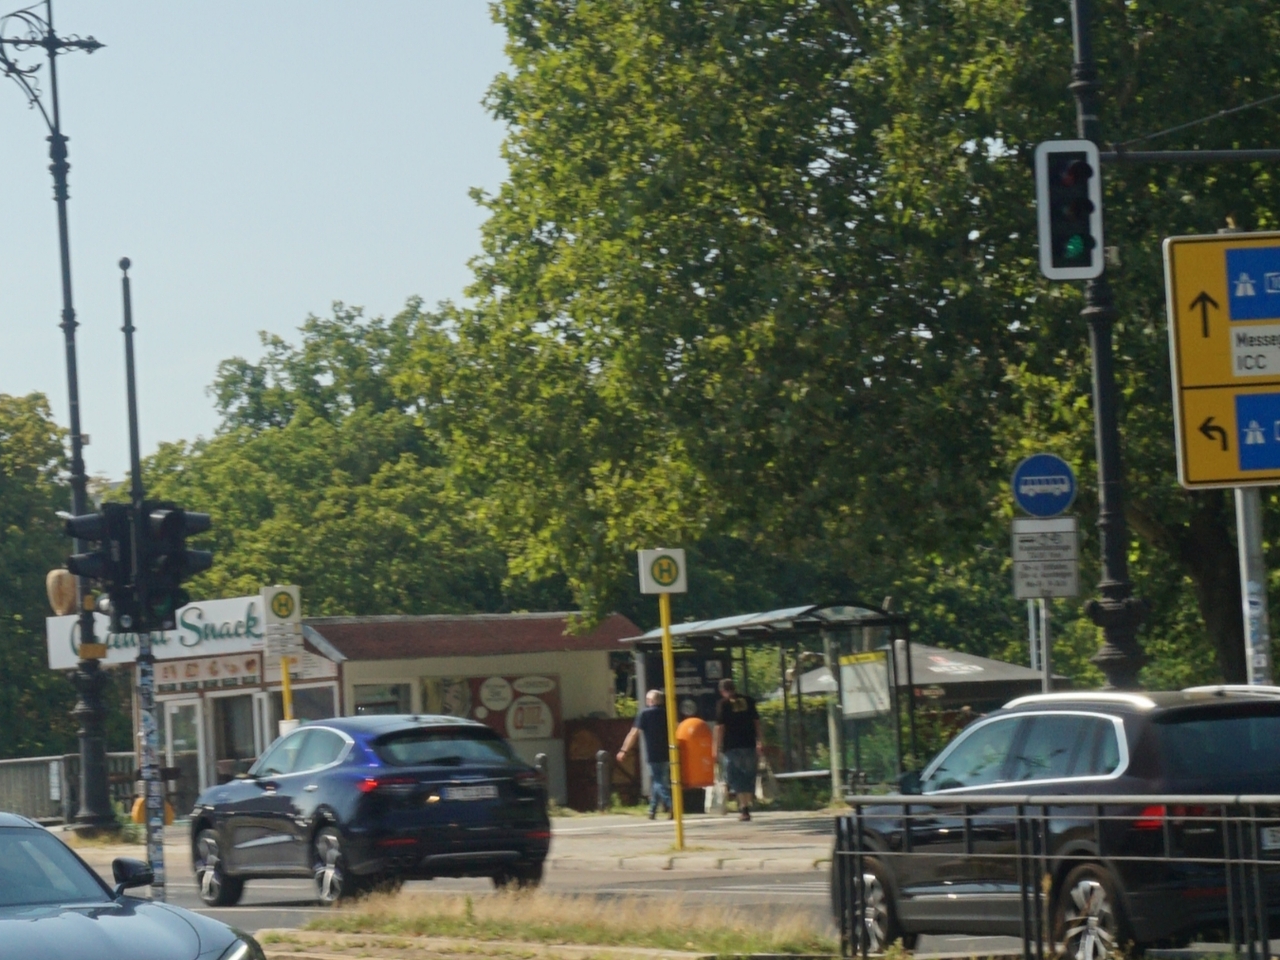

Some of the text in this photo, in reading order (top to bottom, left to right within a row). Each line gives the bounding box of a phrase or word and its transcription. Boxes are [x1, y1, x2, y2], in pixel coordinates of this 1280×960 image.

[1235, 332, 1280, 350] Messe
[1237, 354, 1267, 371] ICC
[179, 601, 265, 647] Snack
